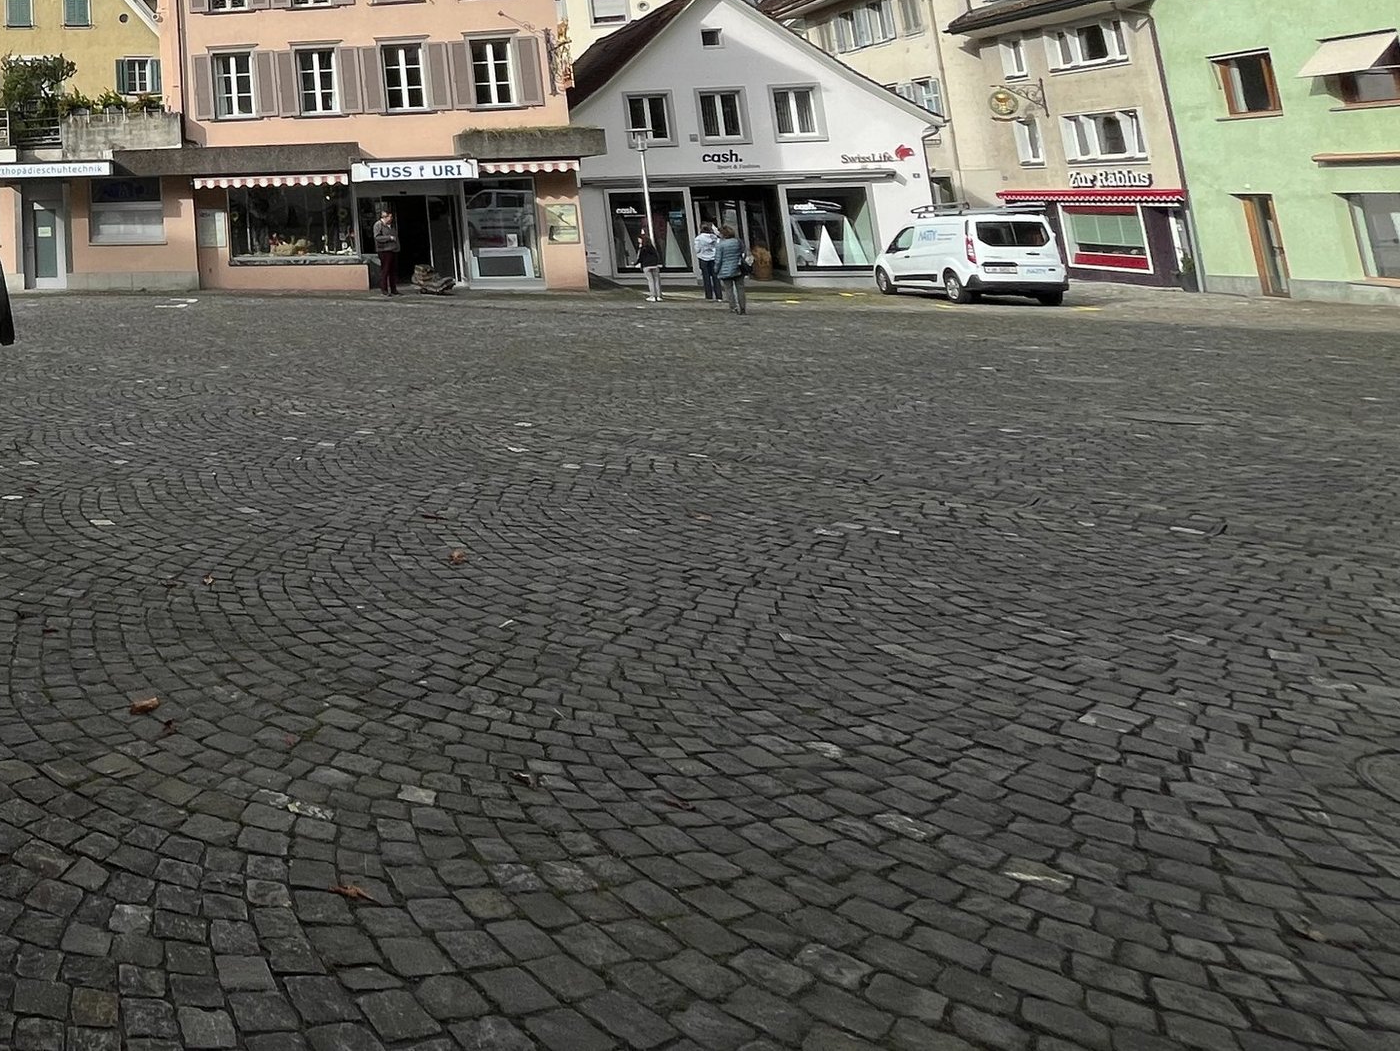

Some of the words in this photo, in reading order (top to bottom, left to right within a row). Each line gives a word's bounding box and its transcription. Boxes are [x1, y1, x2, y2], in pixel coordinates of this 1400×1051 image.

[702, 149, 743, 162] cash.
[370, 166, 412, 178] FUSS
[432, 164, 462, 177] URI
[1068, 171, 1096, 188] Zur
